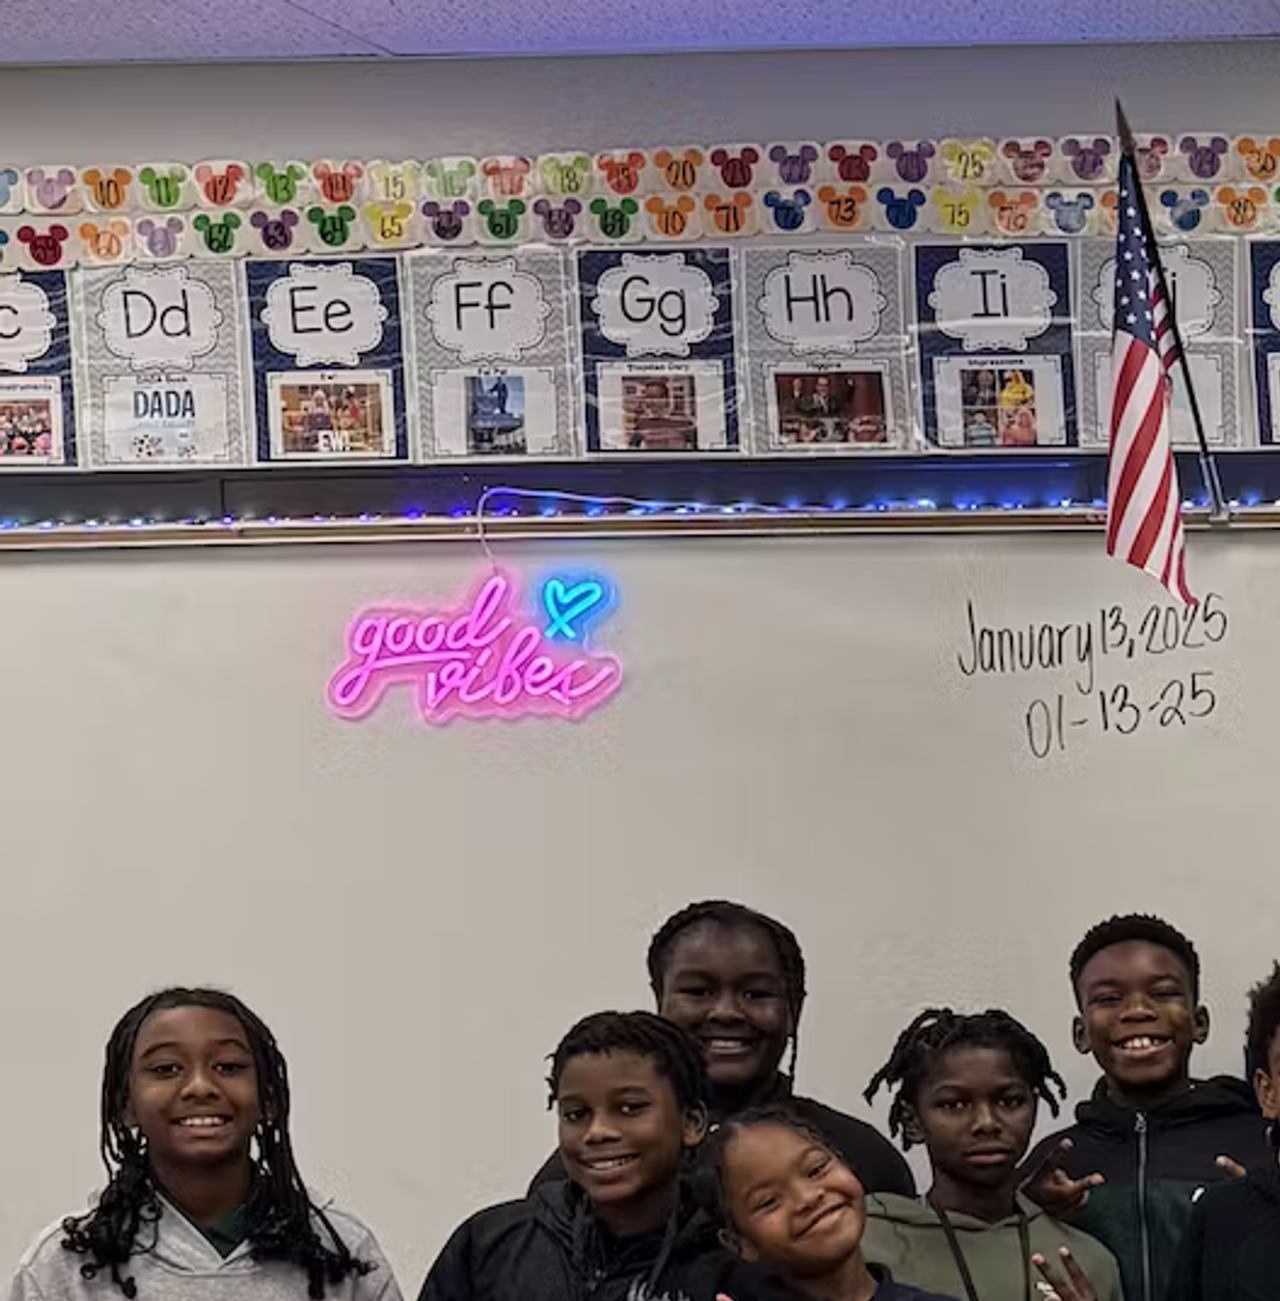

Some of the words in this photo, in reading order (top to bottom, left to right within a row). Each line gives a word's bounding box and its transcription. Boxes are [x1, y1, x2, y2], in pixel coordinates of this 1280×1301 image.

[384, 176, 404, 200] 15
[560, 169, 580, 193] 18
[380, 217, 402, 239] 65
[715, 205, 741, 232] 71
[828, 198, 856, 222] 73
[943, 203, 970, 227] 75
[122, 289, 192, 339] Dd
[288, 285, 355, 334] Ee
[453, 280, 515, 330] Ff
[620, 275, 688, 337] Gg
[783, 273, 854, 323] Hh
[970, 269, 1010, 318] Ii
[133, 389, 197, 419] DADA
[334, 575, 514, 707] good
[957, 598, 1095, 696] January
[425, 626, 616, 711] vibes
